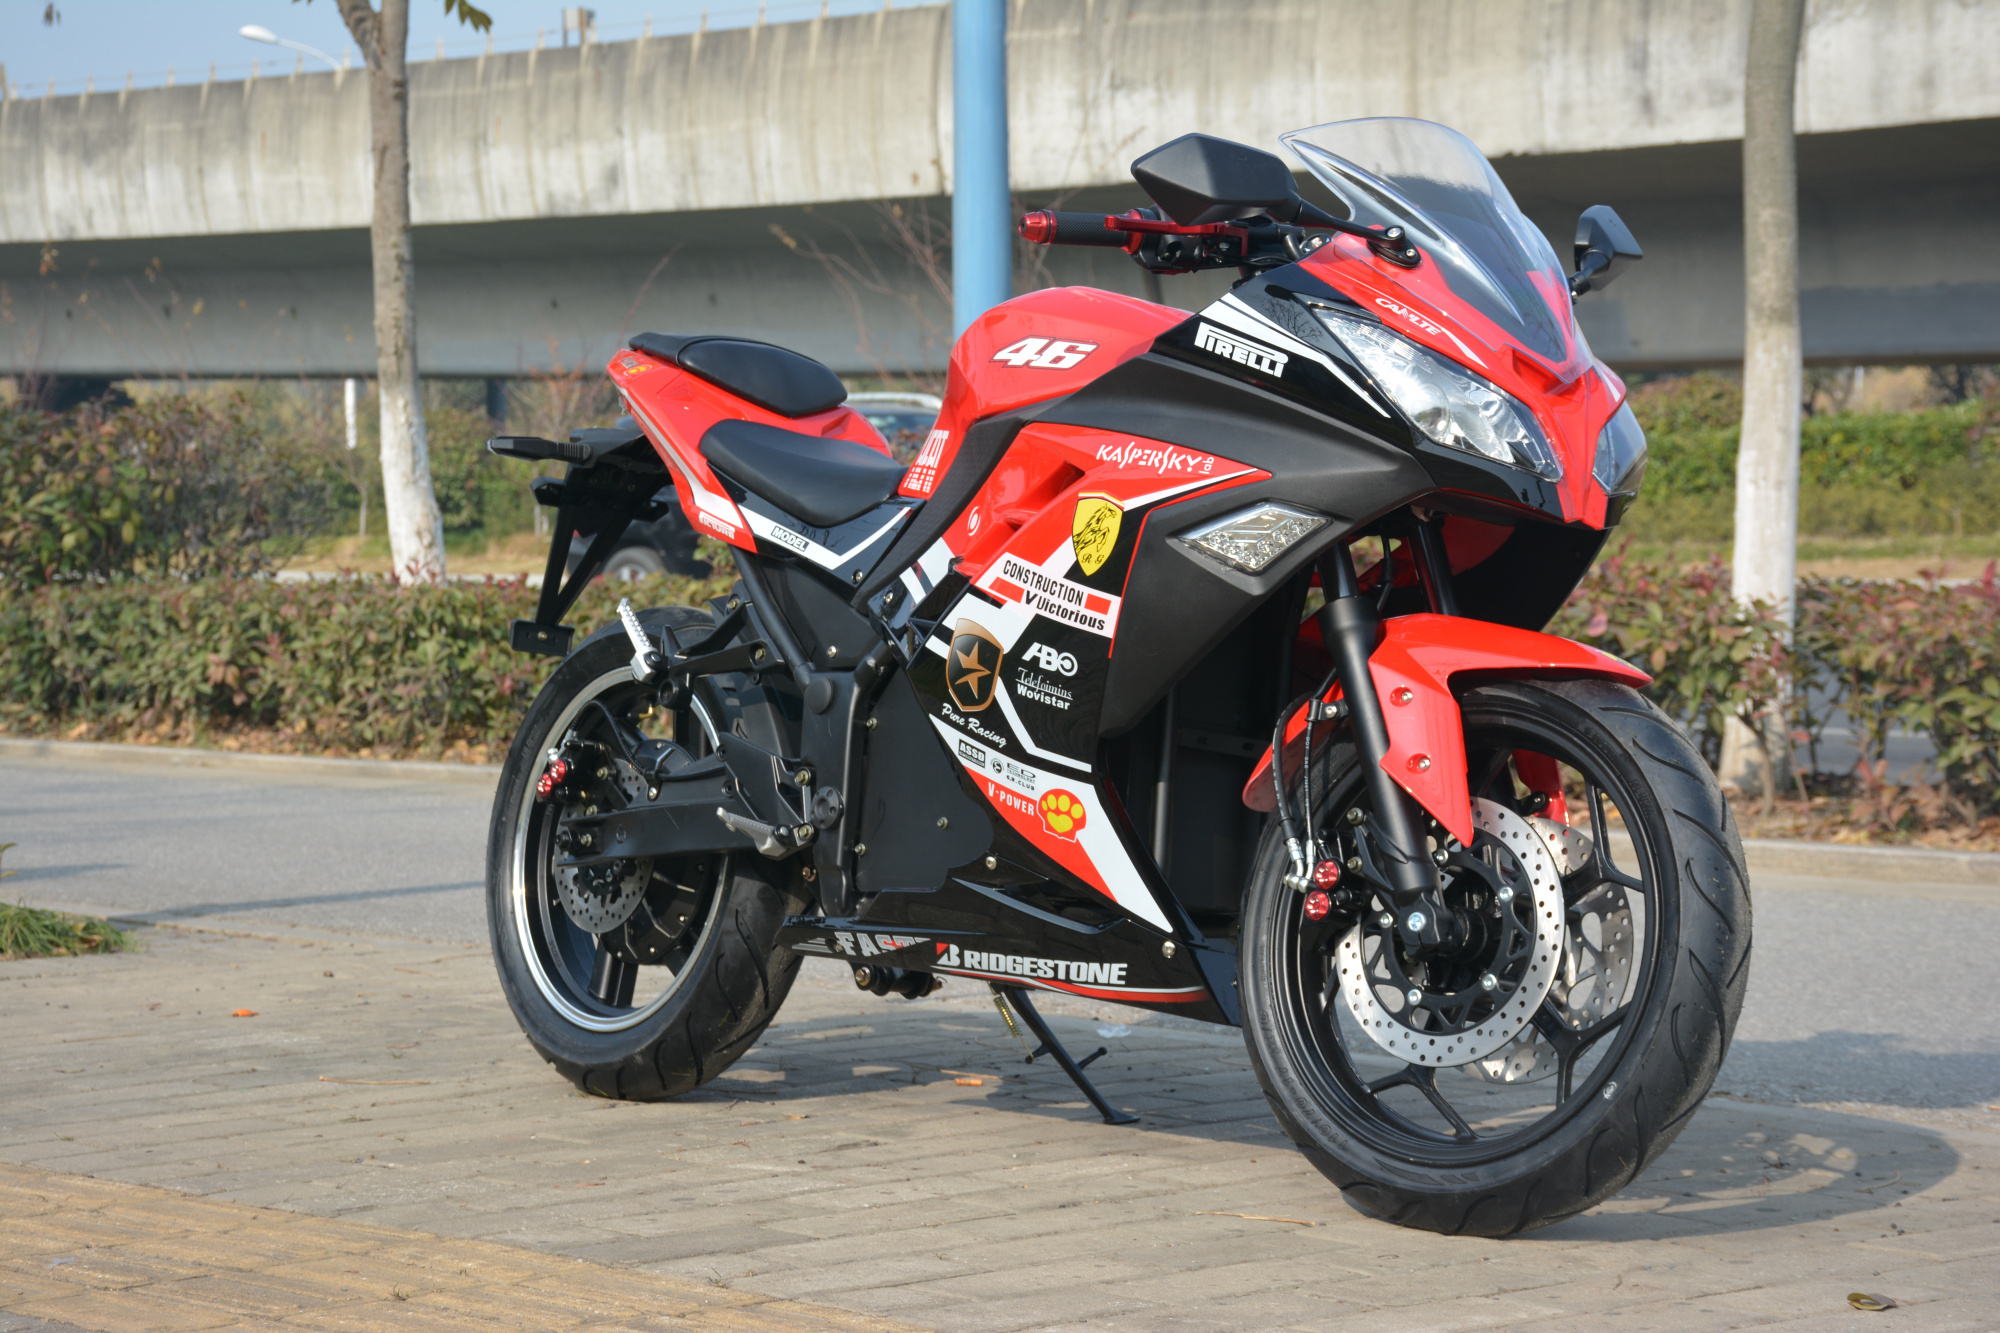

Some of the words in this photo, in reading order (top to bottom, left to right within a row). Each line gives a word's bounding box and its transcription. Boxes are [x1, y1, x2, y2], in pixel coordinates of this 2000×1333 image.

[991, 335, 1099, 371] 46
[1194, 321, 1289, 378] PIRELLI
[1096, 441, 1203, 475] KASPERSKY
[1198, 456, 1215, 475] lab
[772, 527, 806, 552] MODEL
[1003, 559, 1085, 607] CONSTRUCTION
[941, 702, 966, 726] Pure
[967, 717, 1007, 748] Racing
[959, 742, 985, 762] ASSD
[988, 781, 1035, 816] V-POWER
[937, 943, 1128, 985] BRIDGESTONE
